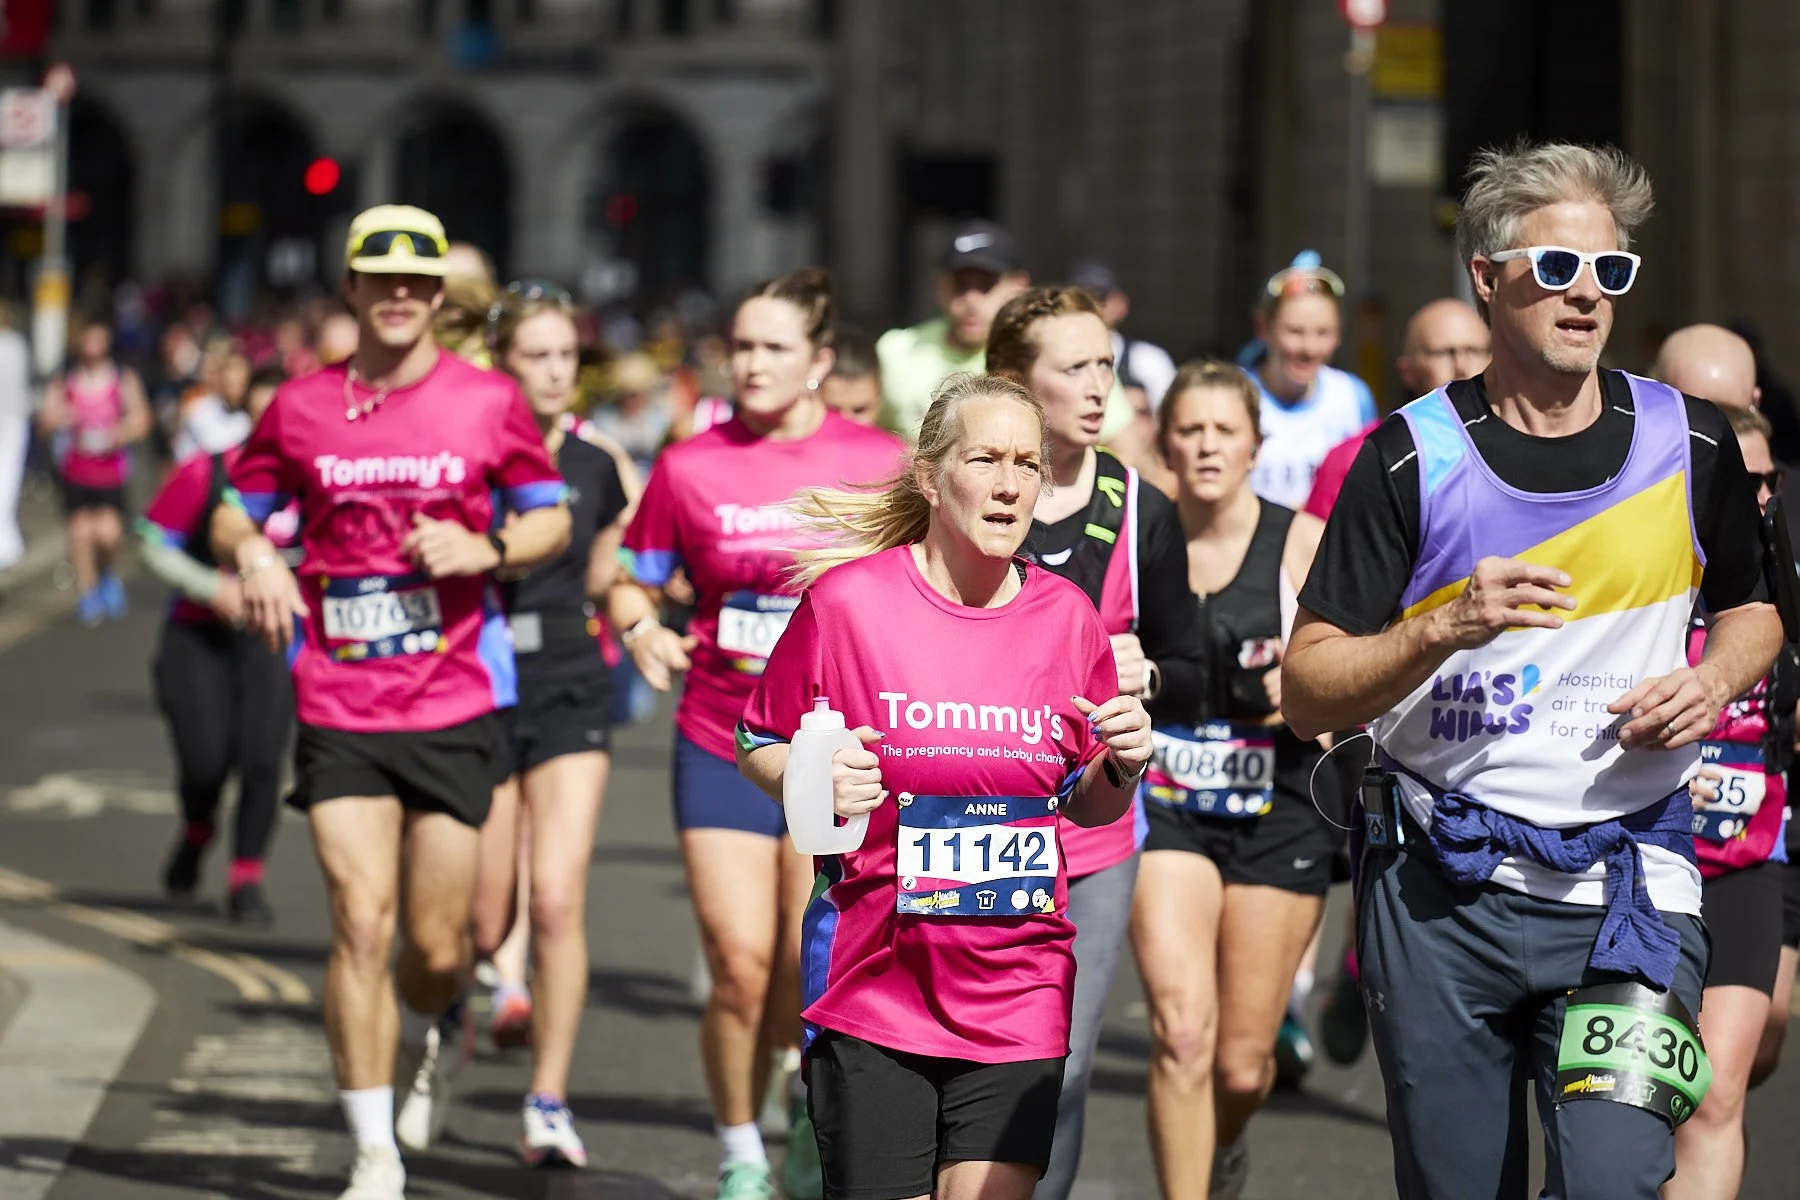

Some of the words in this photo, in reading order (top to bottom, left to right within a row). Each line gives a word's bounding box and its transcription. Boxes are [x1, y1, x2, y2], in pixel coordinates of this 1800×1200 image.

[314, 450, 466, 489] Tommy's
[1430, 670, 1516, 706] LIA'S
[1557, 671, 1634, 690] Hospital
[1551, 696, 1575, 711] air
[878, 691, 1064, 745] Tommy's
[1549, 720, 1578, 737] for
[881, 744, 903, 757] The
[905, 745, 974, 759] pregnancy
[977, 745, 1000, 758] and
[1003, 748, 1033, 763] baby
[964, 803, 1008, 816] ANNE
[912, 831, 1049, 872] 11142
[1581, 1015, 1699, 1083] 8430
